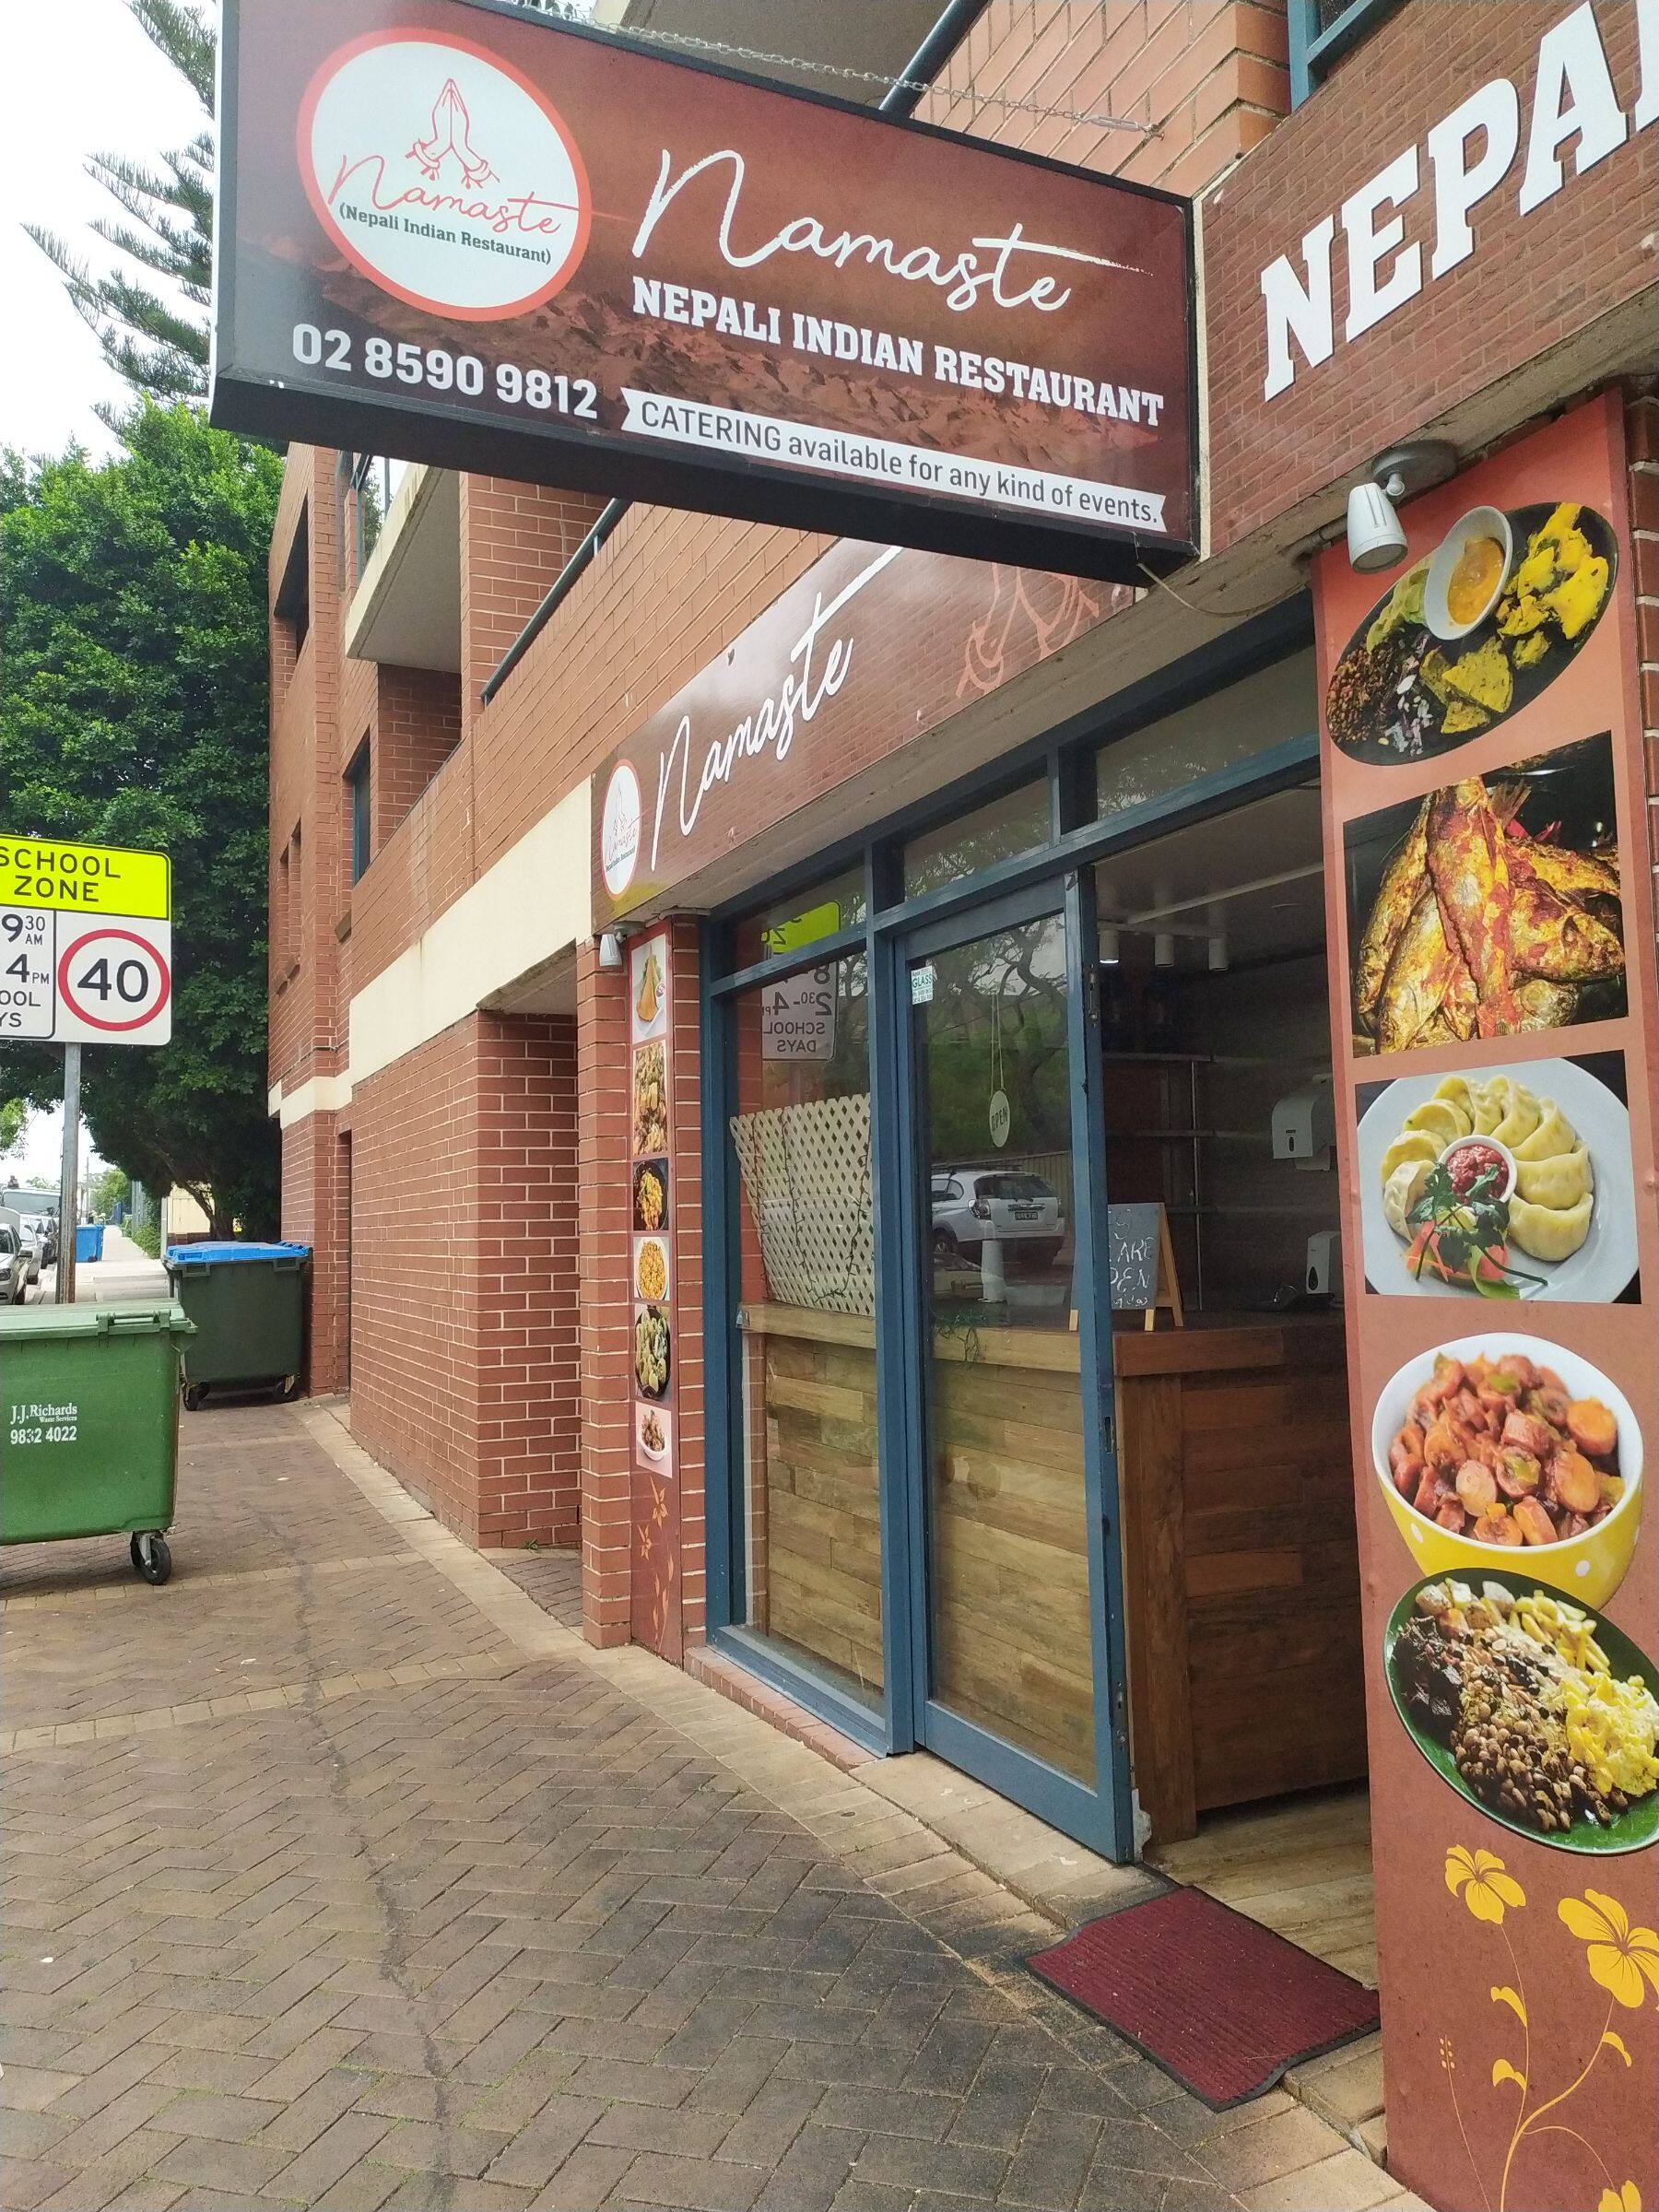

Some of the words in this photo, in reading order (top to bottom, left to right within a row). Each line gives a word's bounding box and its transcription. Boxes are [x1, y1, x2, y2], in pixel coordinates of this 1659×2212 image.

[327, 154, 580, 234] Namaste
[338, 202, 400, 229] (Nepali
[404, 218, 456, 243] Indian
[461, 230, 552, 265] Restaurant)
[632, 148, 1154, 312] Namaste
[292, 323, 352, 371] 02
[364, 337, 484, 395] 8590
[496, 362, 598, 419] 9812
[632, 276, 781, 346] NEPALI
[793, 312, 924, 377] INDIAN
[934, 345, 1164, 427] RESTAURANT
[641, 400, 782, 452] CATERING
[788, 435, 903, 475] available
[909, 453, 944, 483] for
[949, 467, 991, 497] any
[997, 470, 1045, 502] kind
[1051, 485, 1075, 507] of
[1079, 492, 1159, 524] events.
[650, 545, 905, 872] Namaste
[14, 875, 100, 902] ZONE
[25, 933, 43, 946] AM
[0, 990, 41, 1007] OOL
[77, 957, 149, 1004] 40
[912, 972, 933, 988] GLASS
[991, 1109, 1008, 1132] OPEN
[45, 1425, 77, 1442] 4022
